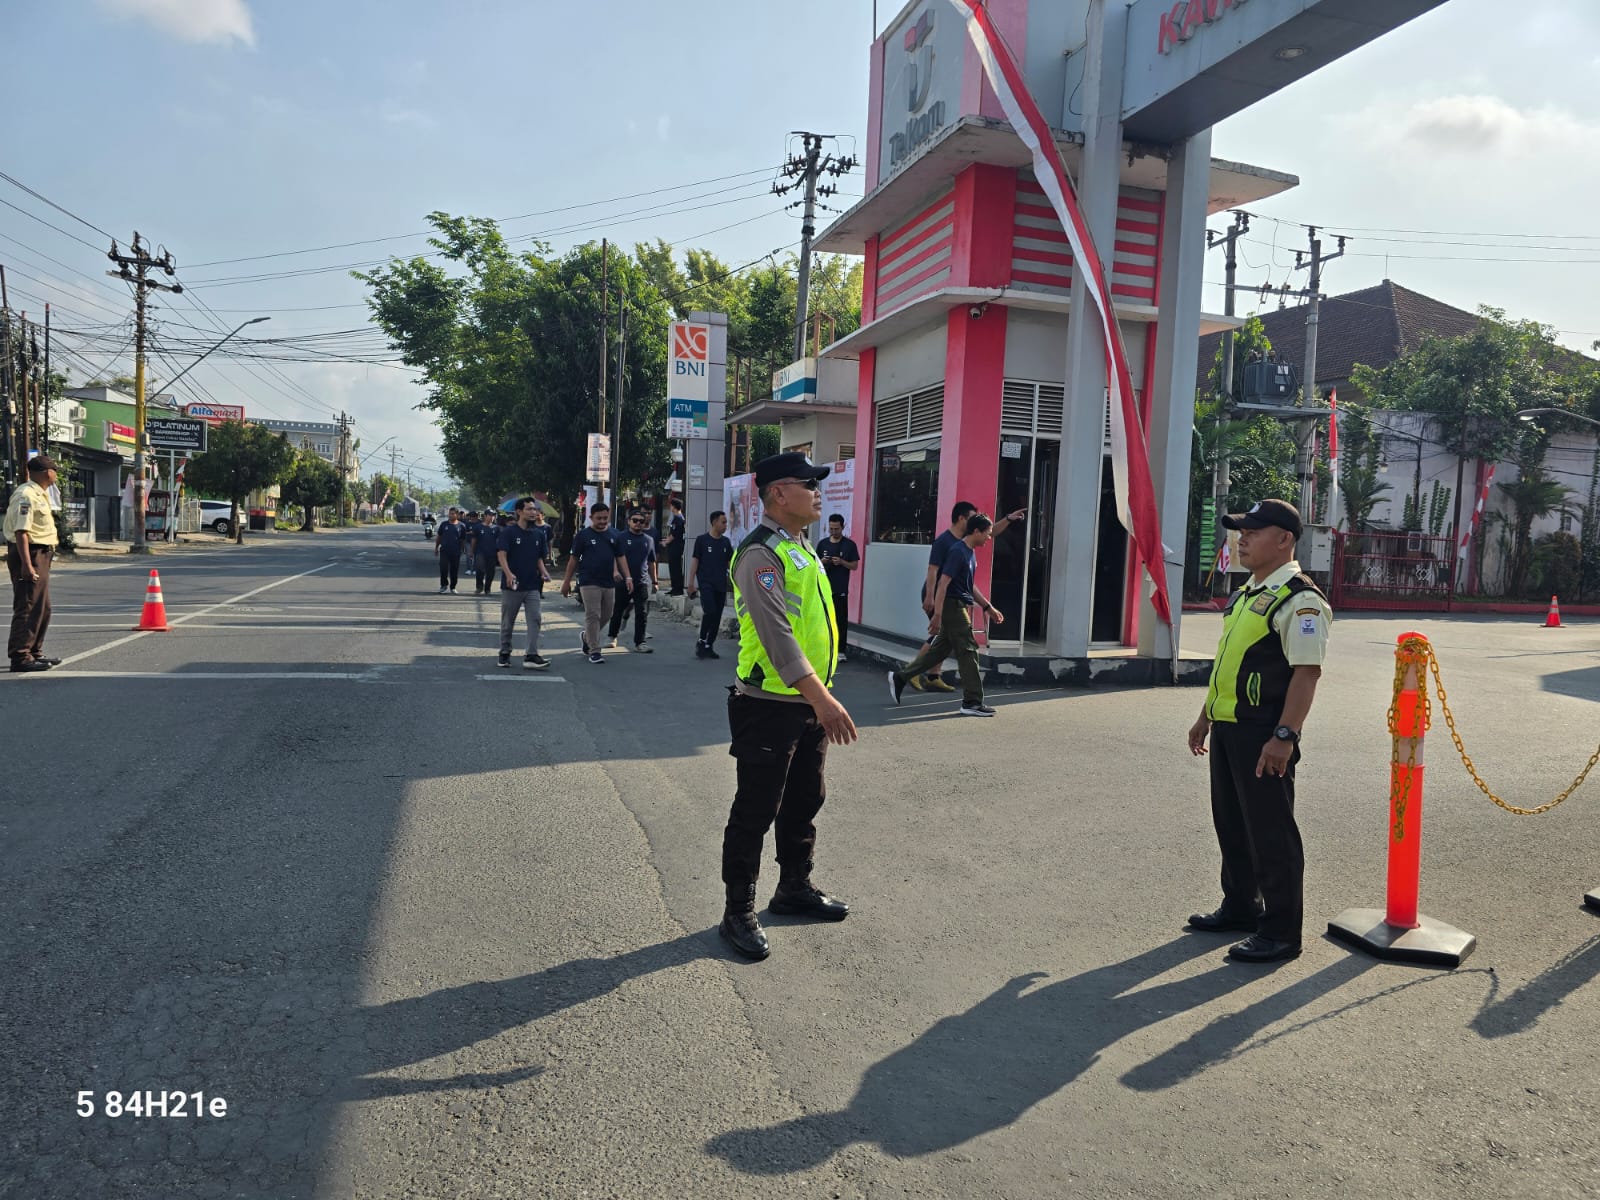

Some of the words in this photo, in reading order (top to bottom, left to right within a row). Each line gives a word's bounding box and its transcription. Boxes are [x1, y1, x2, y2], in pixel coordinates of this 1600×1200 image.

[889, 101, 945, 165] Telkom
[676, 360, 705, 377] BNI
[191, 406, 238, 418] Alfamart
[674, 403, 692, 412] ATM
